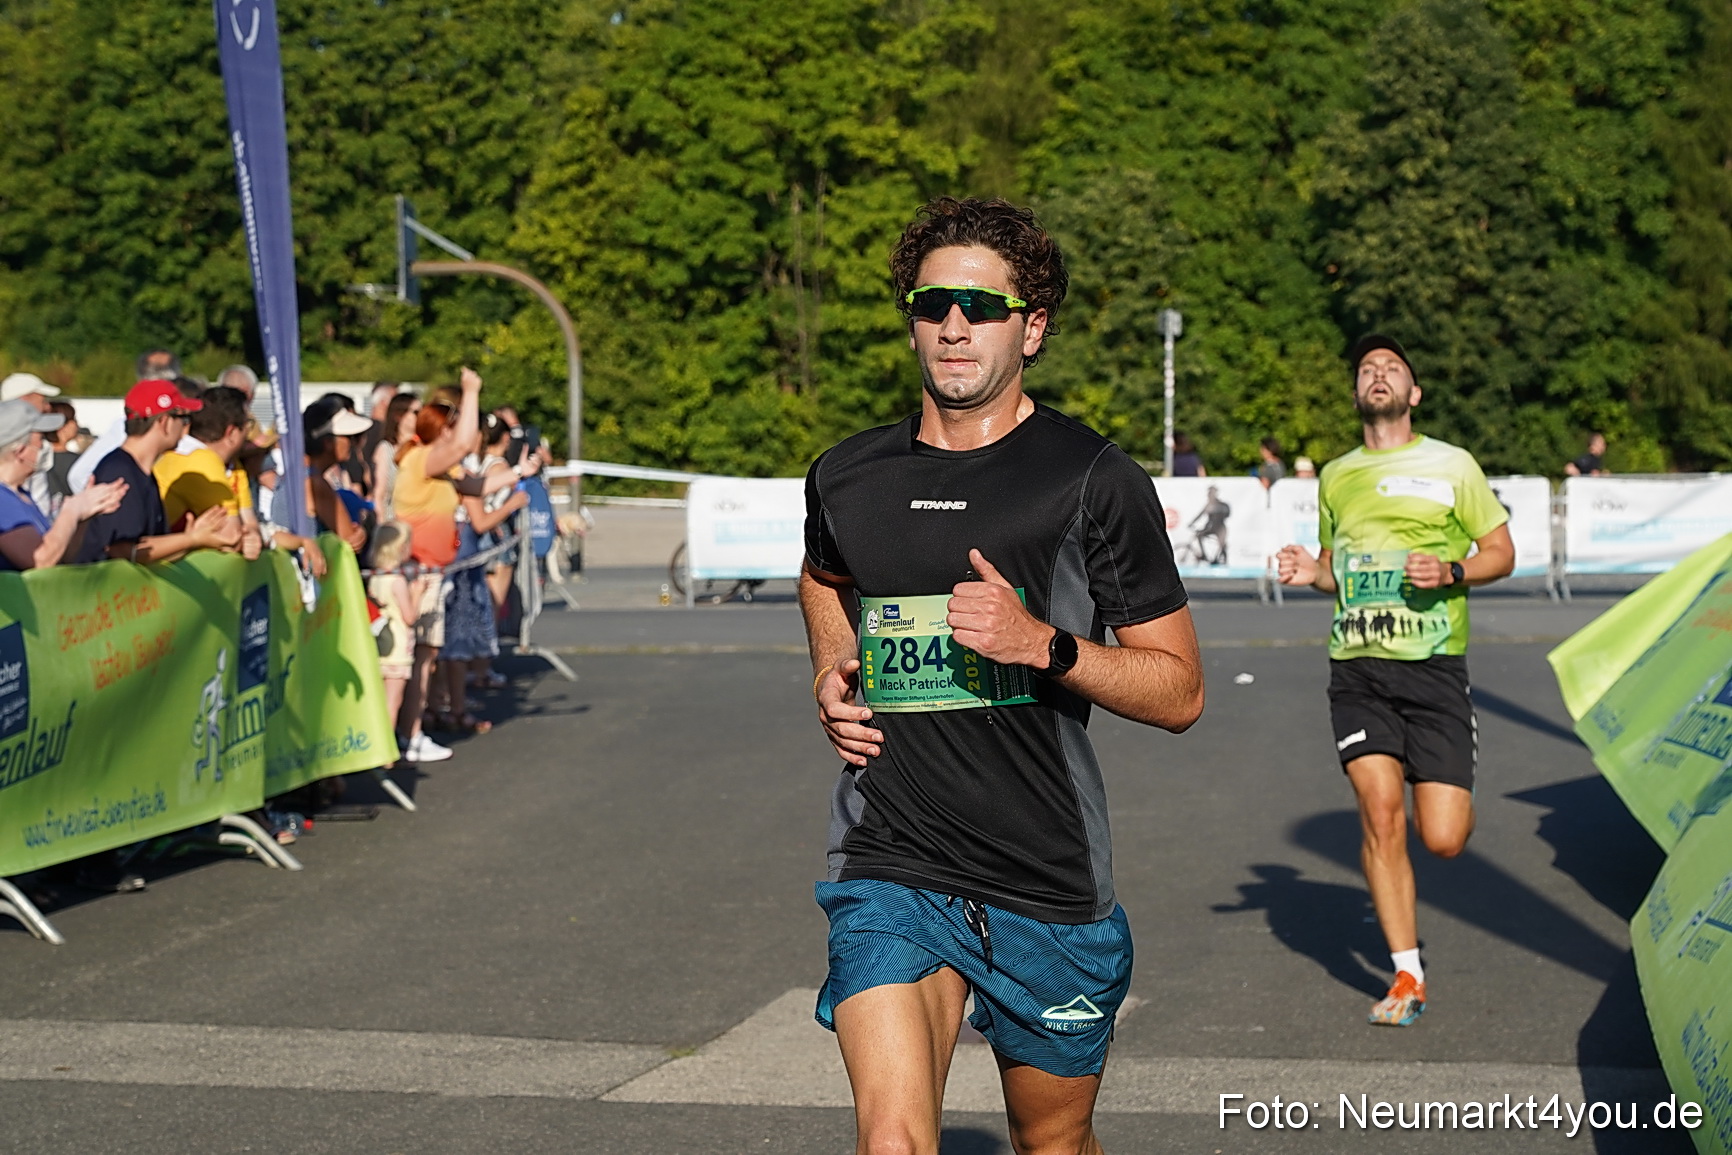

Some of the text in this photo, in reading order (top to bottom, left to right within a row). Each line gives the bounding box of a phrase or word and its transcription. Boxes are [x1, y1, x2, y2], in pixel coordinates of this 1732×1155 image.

[910, 500, 967, 510] STANNO
[1359, 571, 1395, 590] 217
[879, 617, 915, 628] Firmenlauf
[880, 635, 947, 675] 284
[866, 650, 875, 689] RUN
[880, 676, 955, 691] Mack Patrick
[1045, 1021, 1068, 1031] NIKE
